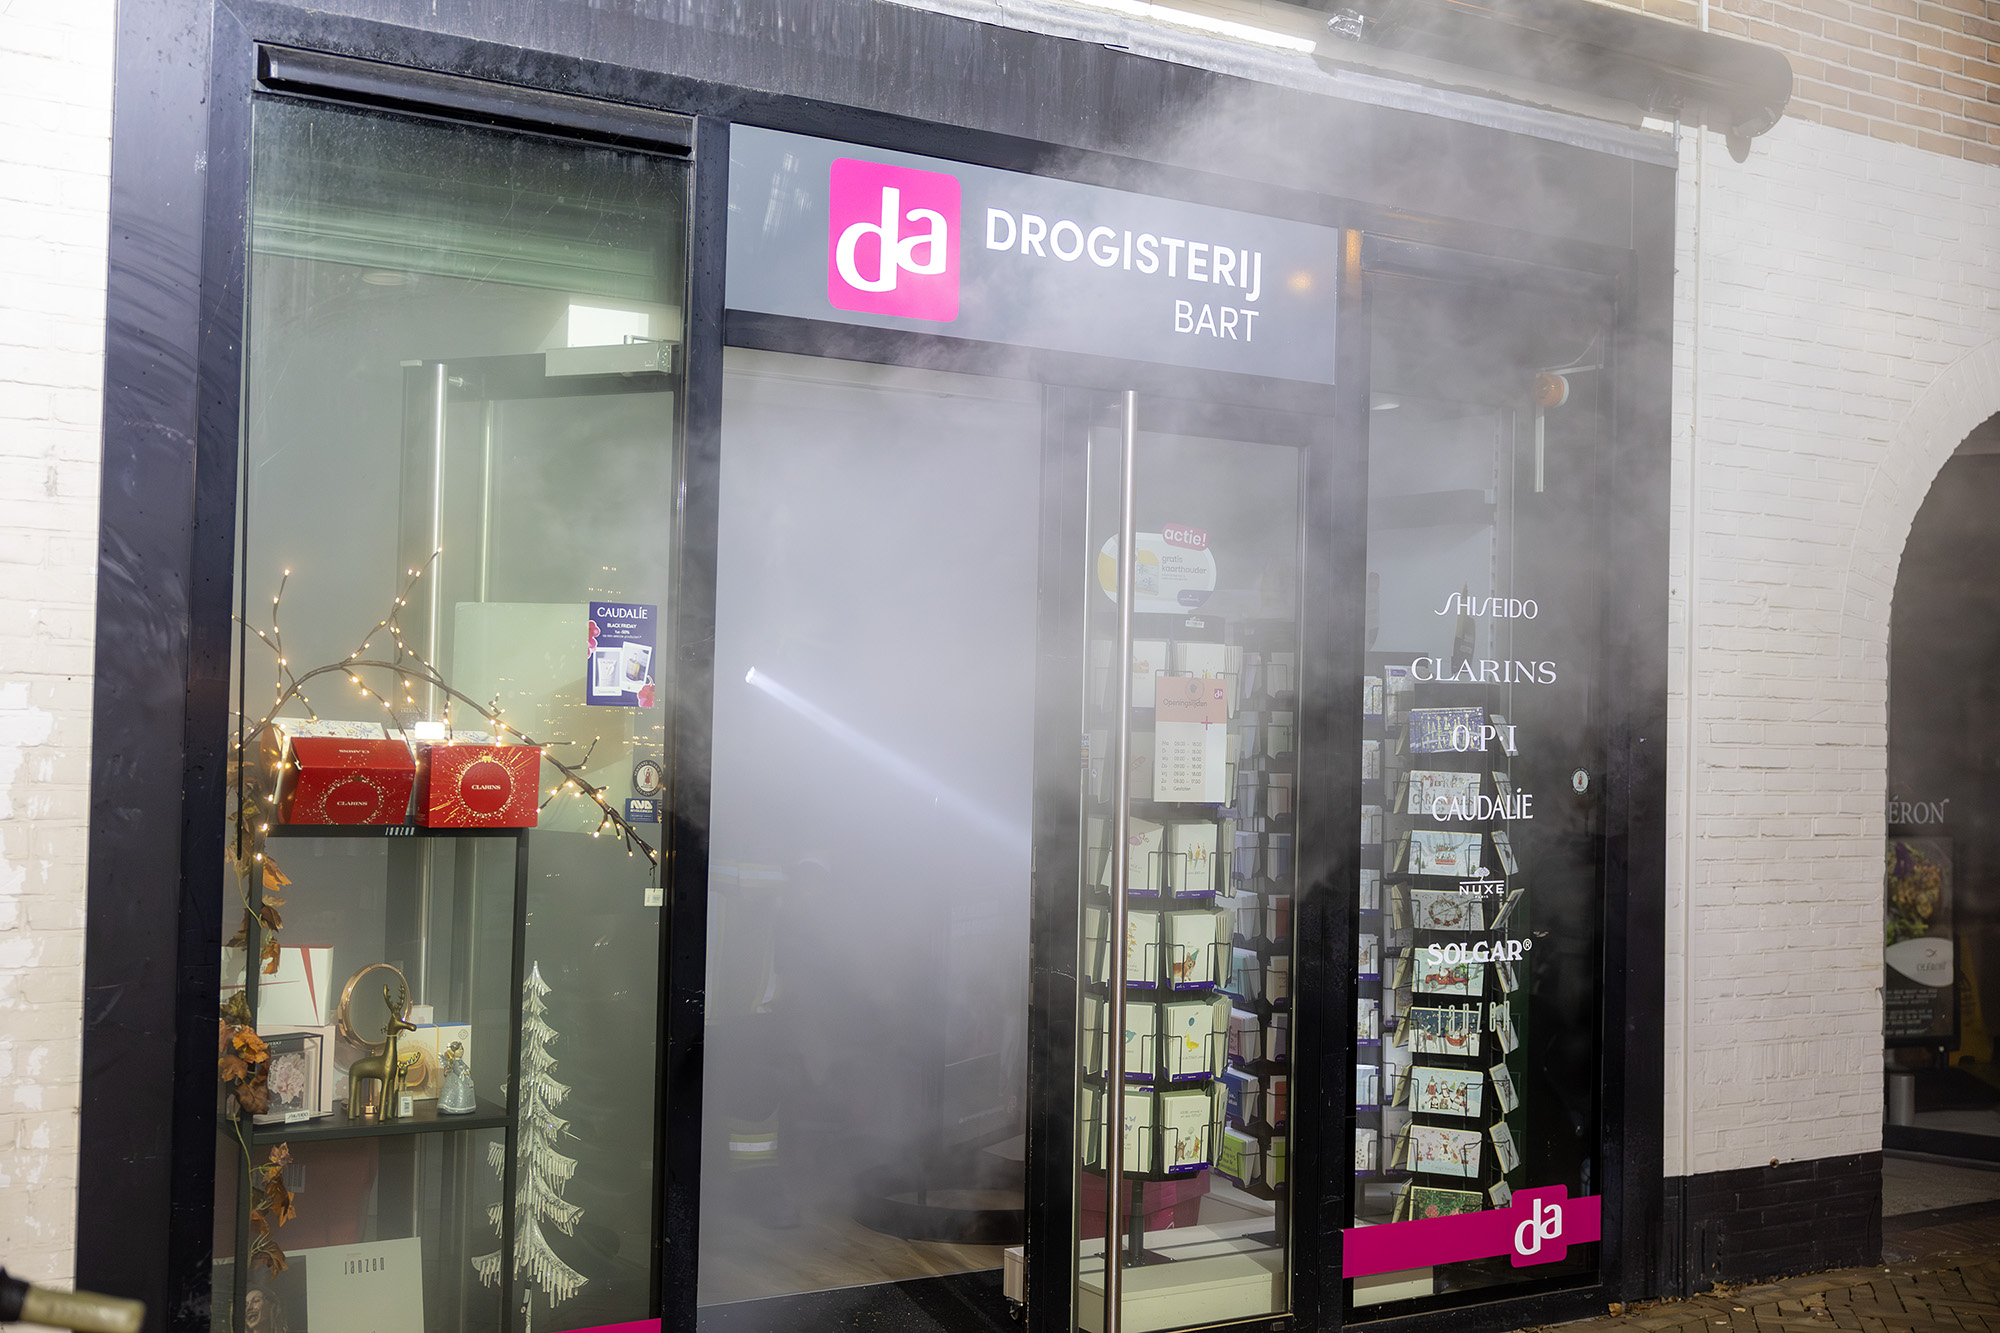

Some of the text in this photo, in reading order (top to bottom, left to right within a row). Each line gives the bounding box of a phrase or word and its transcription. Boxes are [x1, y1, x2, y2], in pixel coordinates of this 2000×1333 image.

[835, 186, 948, 292] da
[986, 207, 1262, 302] DROGISTERIJ
[1174, 299, 1260, 342] BART
[1164, 528, 1207, 547] actie!
[597, 606, 648, 620] CAUDALÍE
[1434, 592, 1538, 619] SHISEIDO
[1411, 657, 1557, 684] CLARINS
[1432, 787, 1533, 821] CAUDALÍE
[1459, 884, 1505, 896] NUXE
[1514, 1198, 1563, 1256] da
